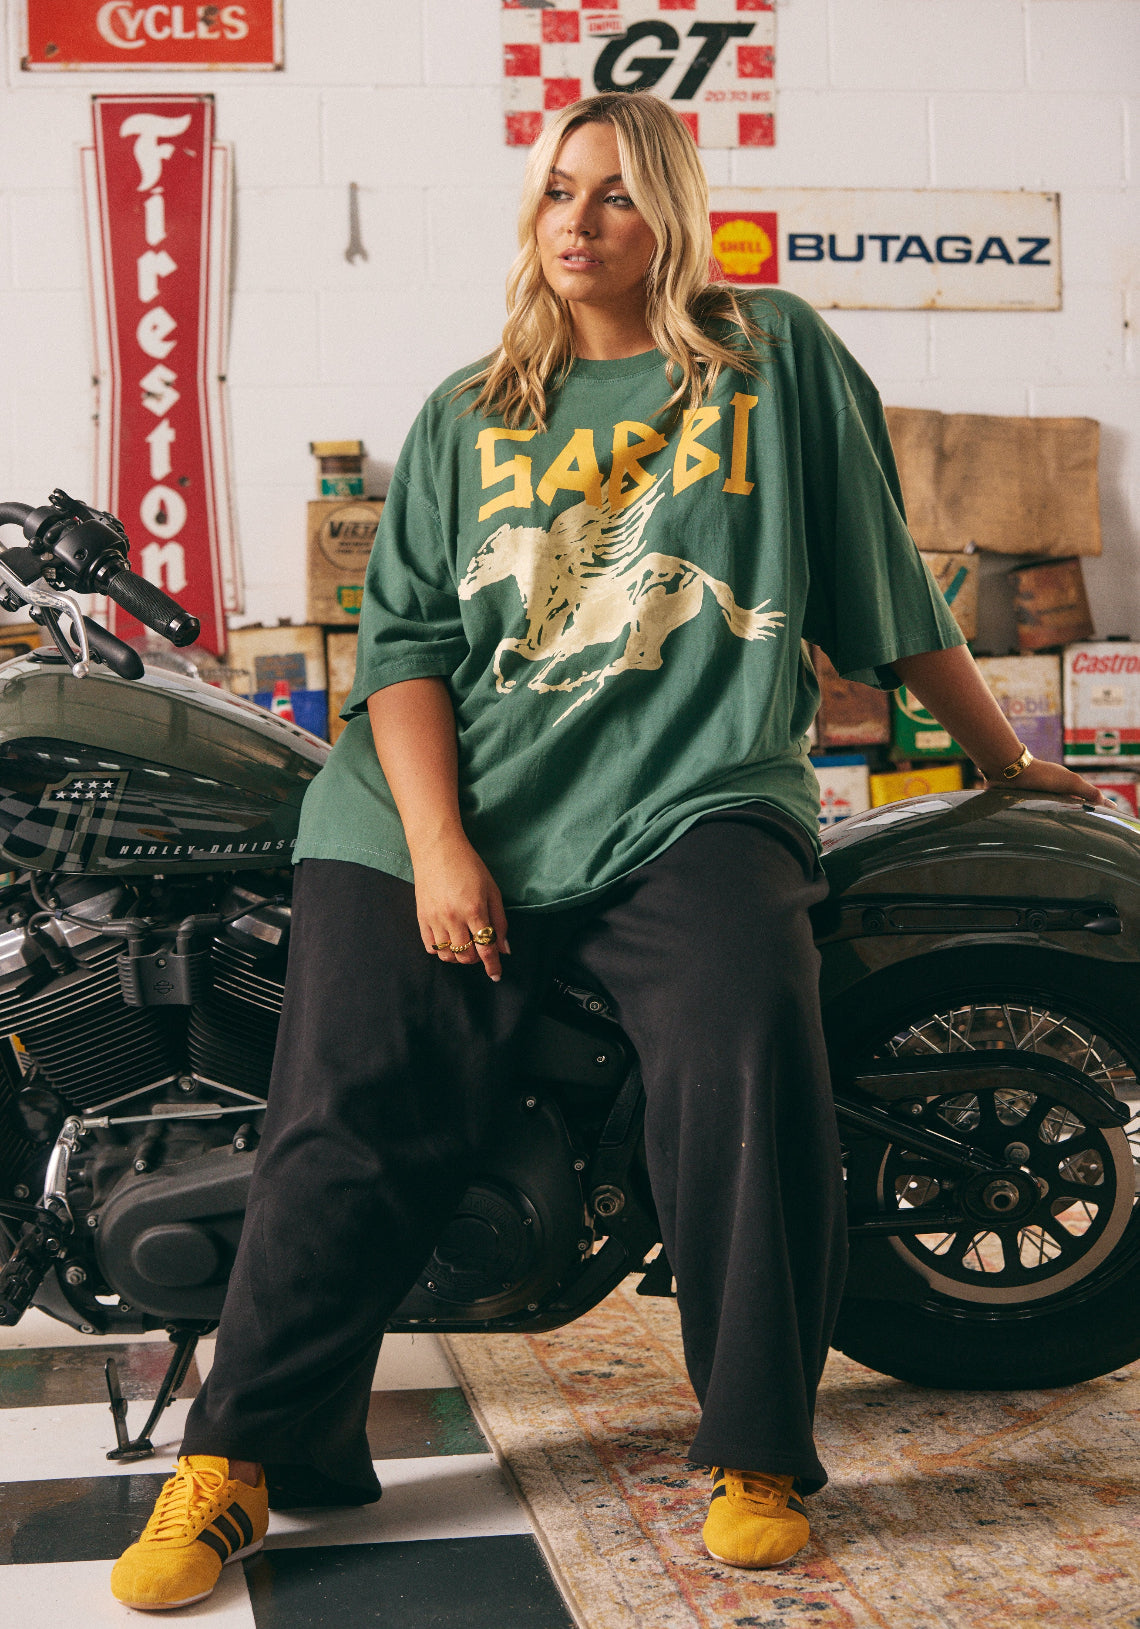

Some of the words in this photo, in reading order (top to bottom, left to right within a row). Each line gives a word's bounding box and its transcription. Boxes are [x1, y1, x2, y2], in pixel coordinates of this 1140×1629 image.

[96, 1, 250, 49] CYCLES
[593, 19, 756, 100] GT
[719, 241, 763, 254] SHELL
[788, 233, 1051, 265] BUTAGAZ
